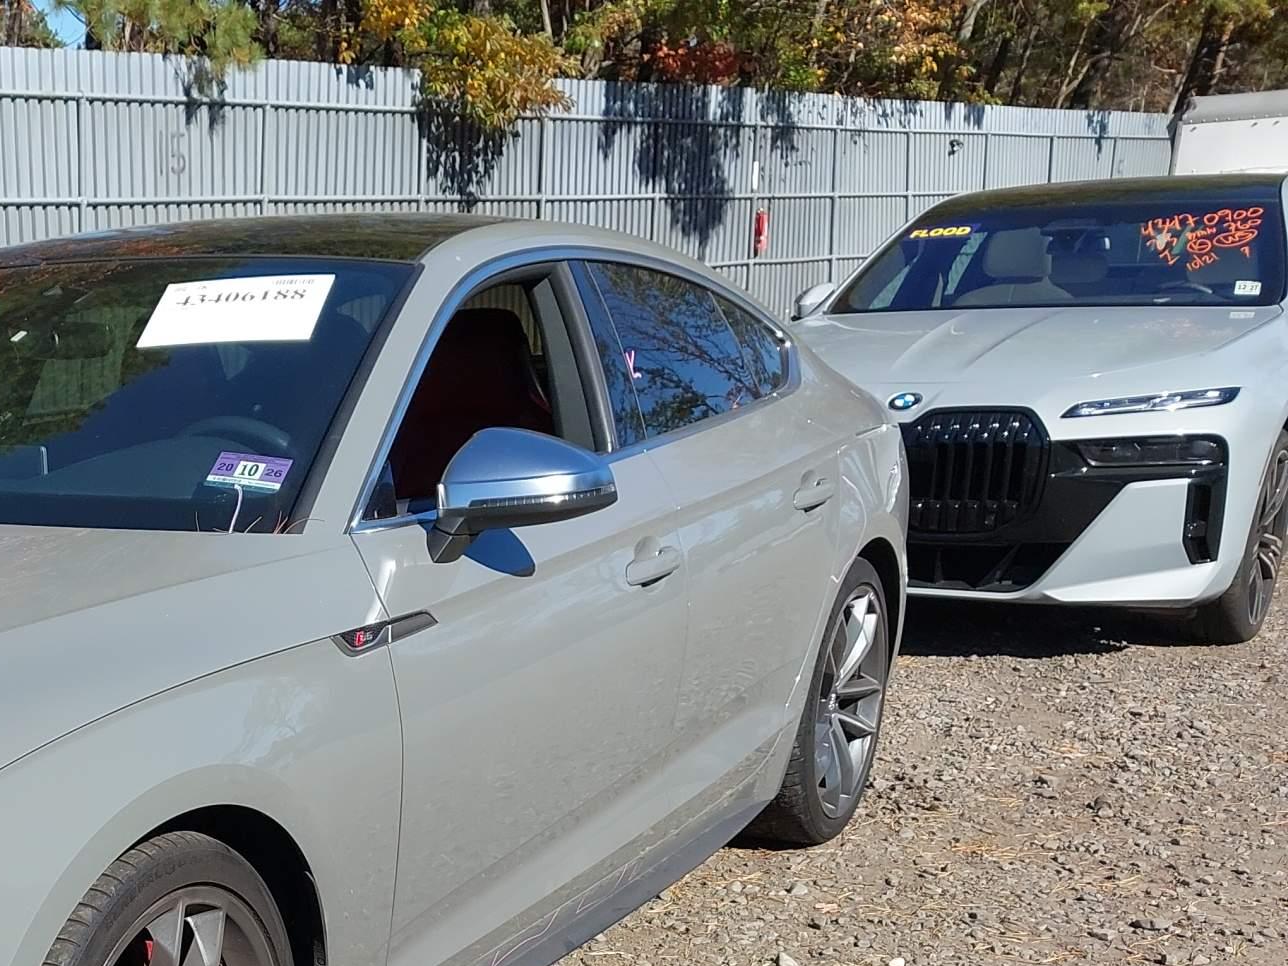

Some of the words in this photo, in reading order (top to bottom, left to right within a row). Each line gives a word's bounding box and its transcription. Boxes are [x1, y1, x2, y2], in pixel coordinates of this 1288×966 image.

[910, 226, 972, 238] FLOOD
[176, 289, 307, 306] 43406188
[217, 462, 234, 472] 20
[238, 463, 260, 477] 10
[264, 468, 283, 478] 26
